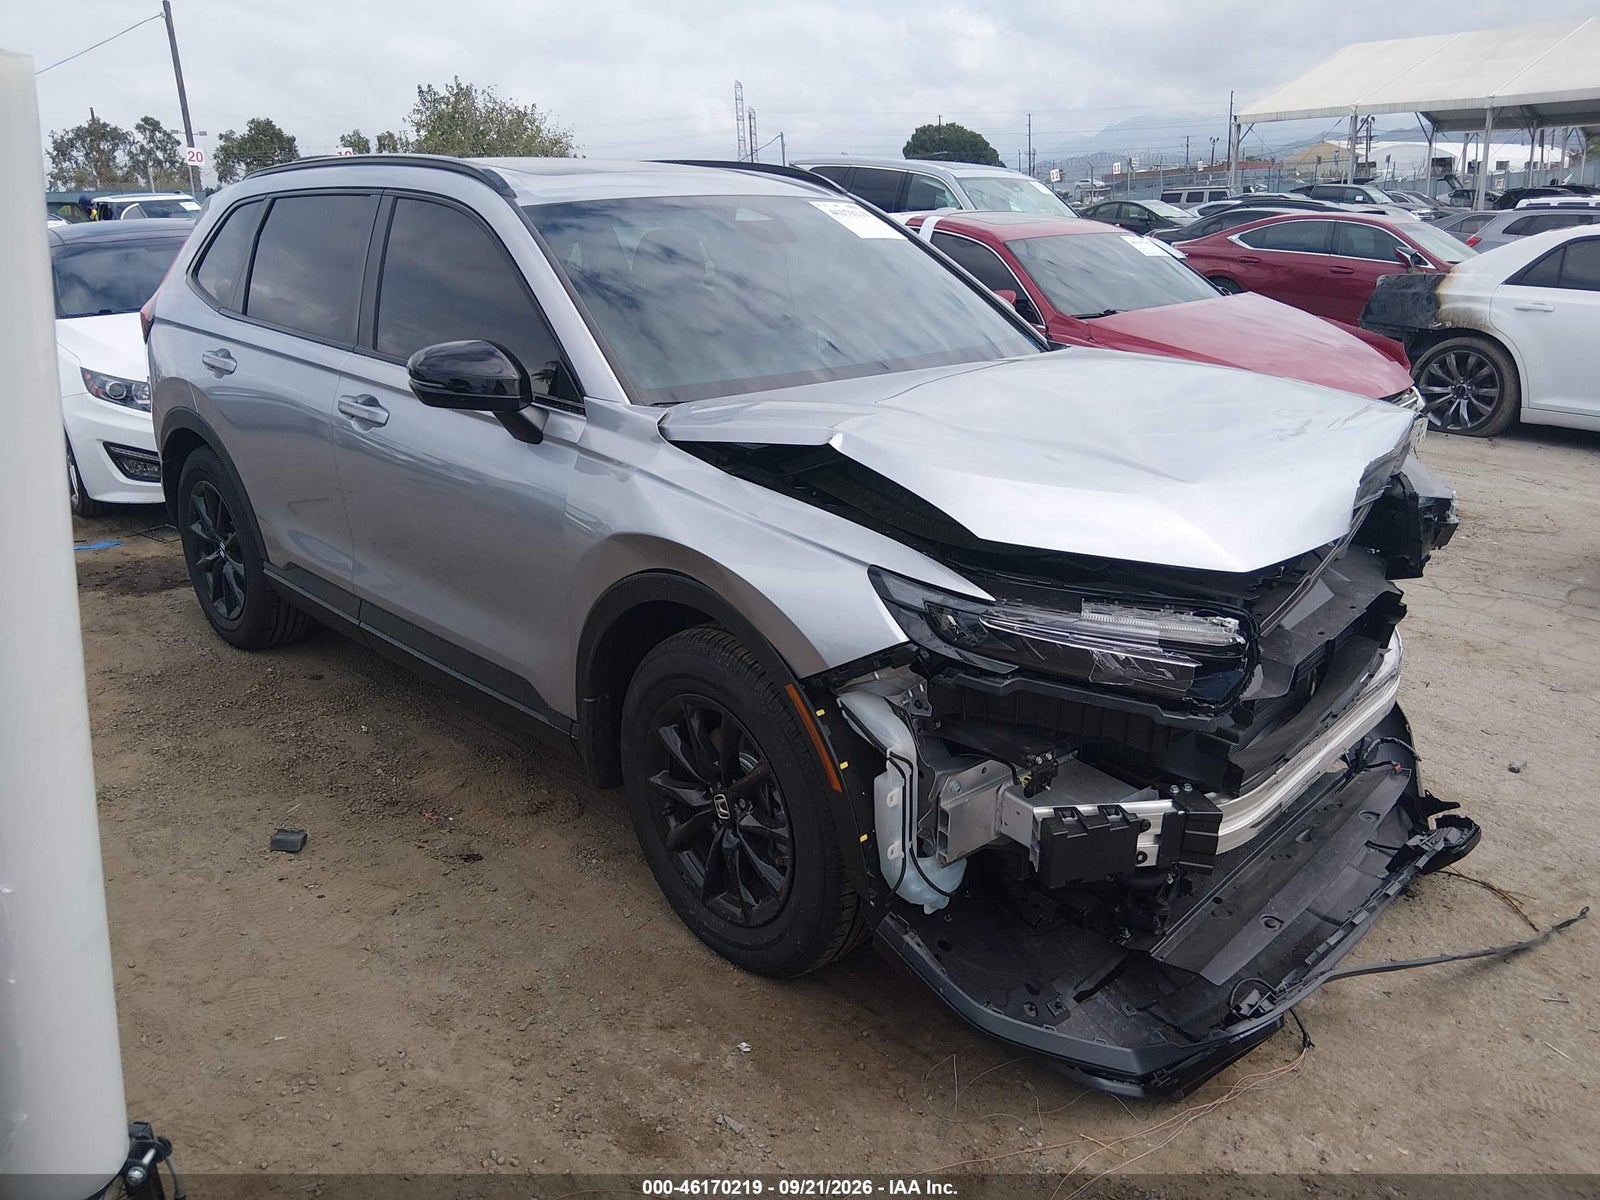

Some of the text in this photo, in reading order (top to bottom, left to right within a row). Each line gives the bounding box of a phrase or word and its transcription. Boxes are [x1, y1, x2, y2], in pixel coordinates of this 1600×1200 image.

[187, 150, 204, 163] 20
[1113, 164, 1120, 172] 11
[1051, 171, 1060, 180] 12
